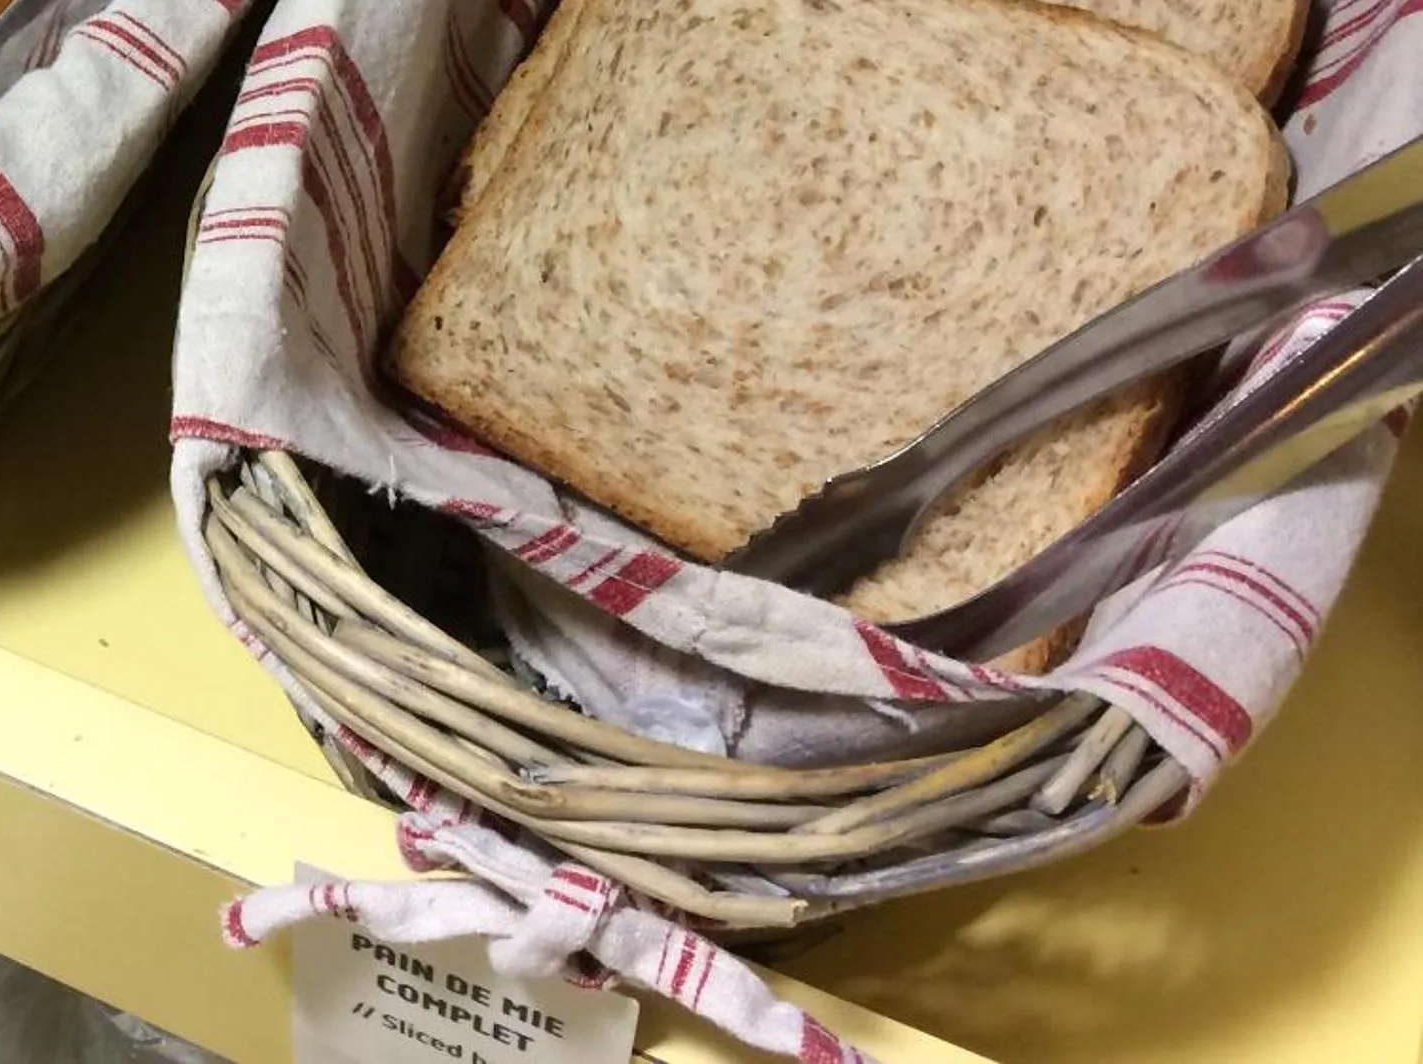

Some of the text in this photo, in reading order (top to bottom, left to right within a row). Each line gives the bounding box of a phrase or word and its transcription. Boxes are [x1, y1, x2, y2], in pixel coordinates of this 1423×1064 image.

[352, 933, 565, 1038] PAIN DE MIE
[377, 974, 535, 1052] COMPLET
[382, 1014, 463, 1058] Sliced
